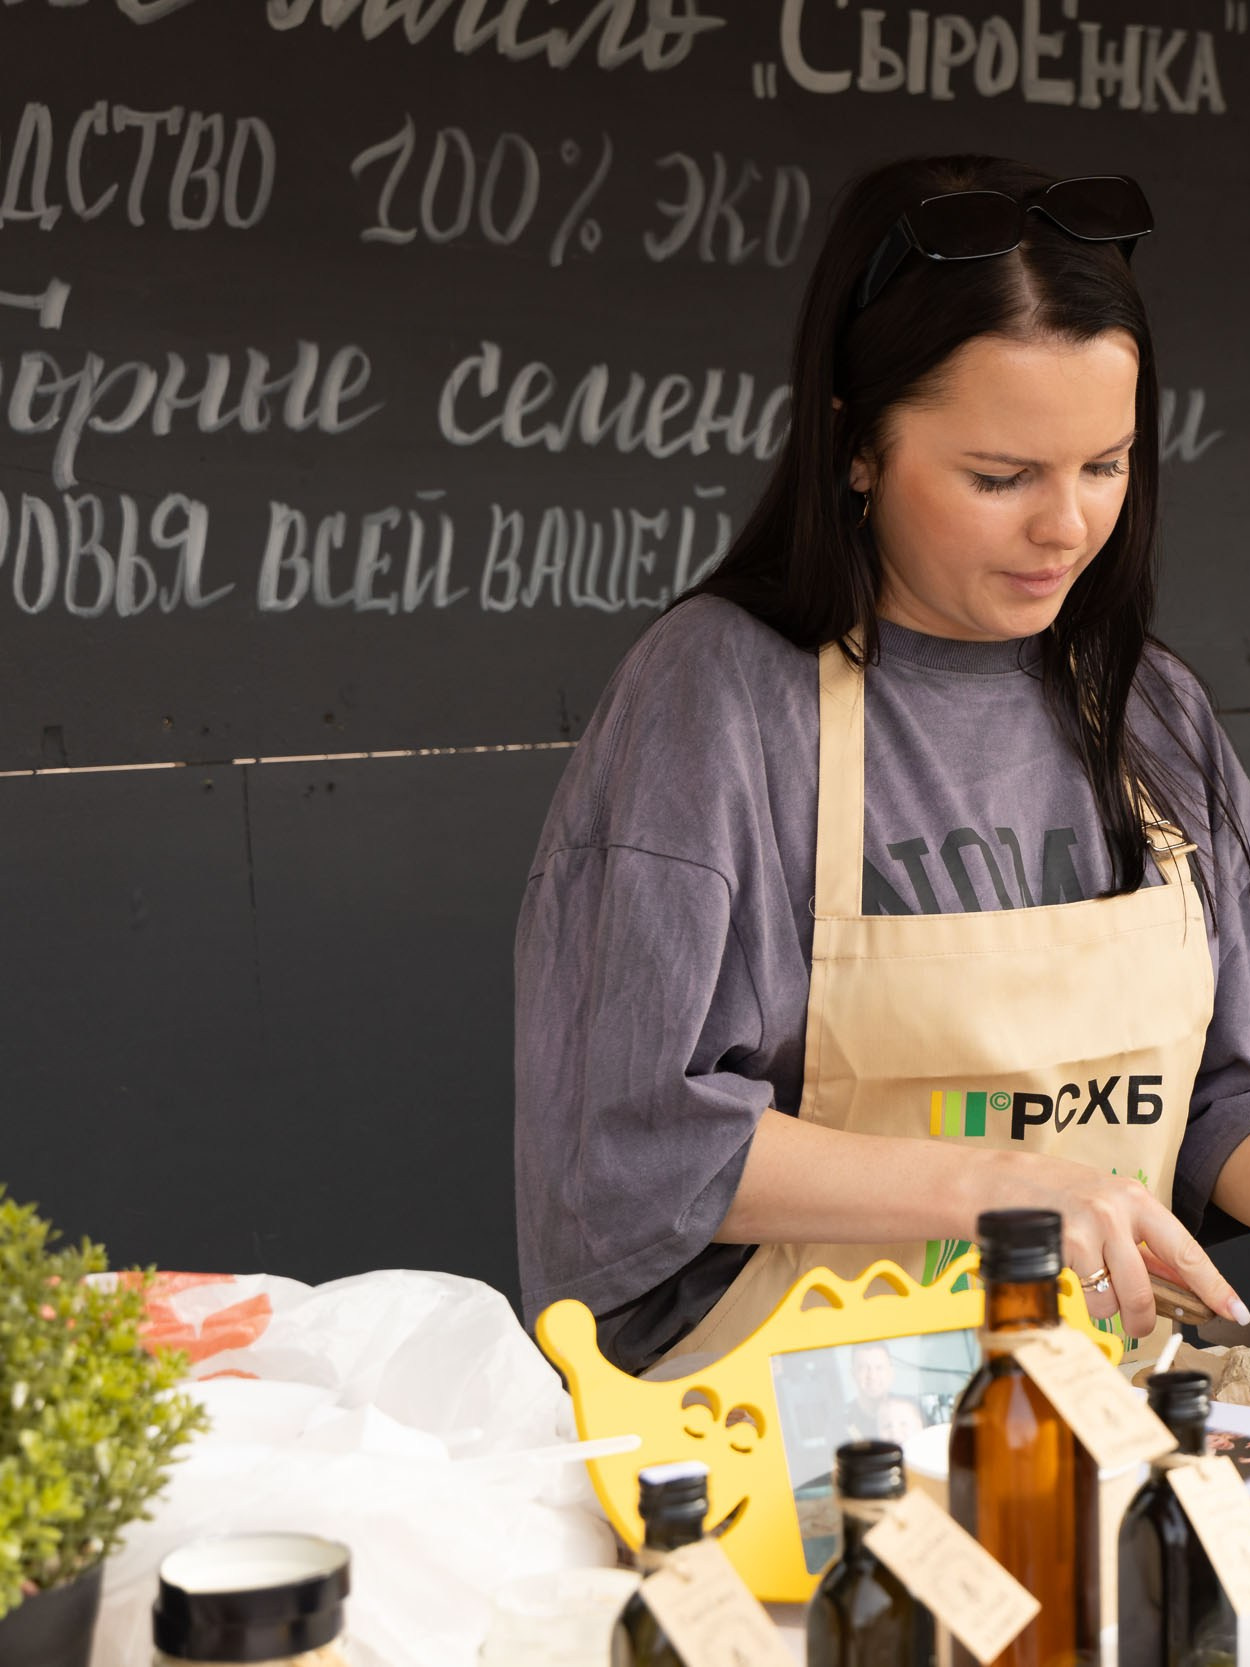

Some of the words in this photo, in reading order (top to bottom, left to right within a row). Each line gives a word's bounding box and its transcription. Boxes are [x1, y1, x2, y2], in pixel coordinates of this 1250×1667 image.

[350, 113, 612, 266] 100%
[258, 489, 470, 614] ВСЕЙ
[1010, 1075, 1164, 1141] РСХБ
